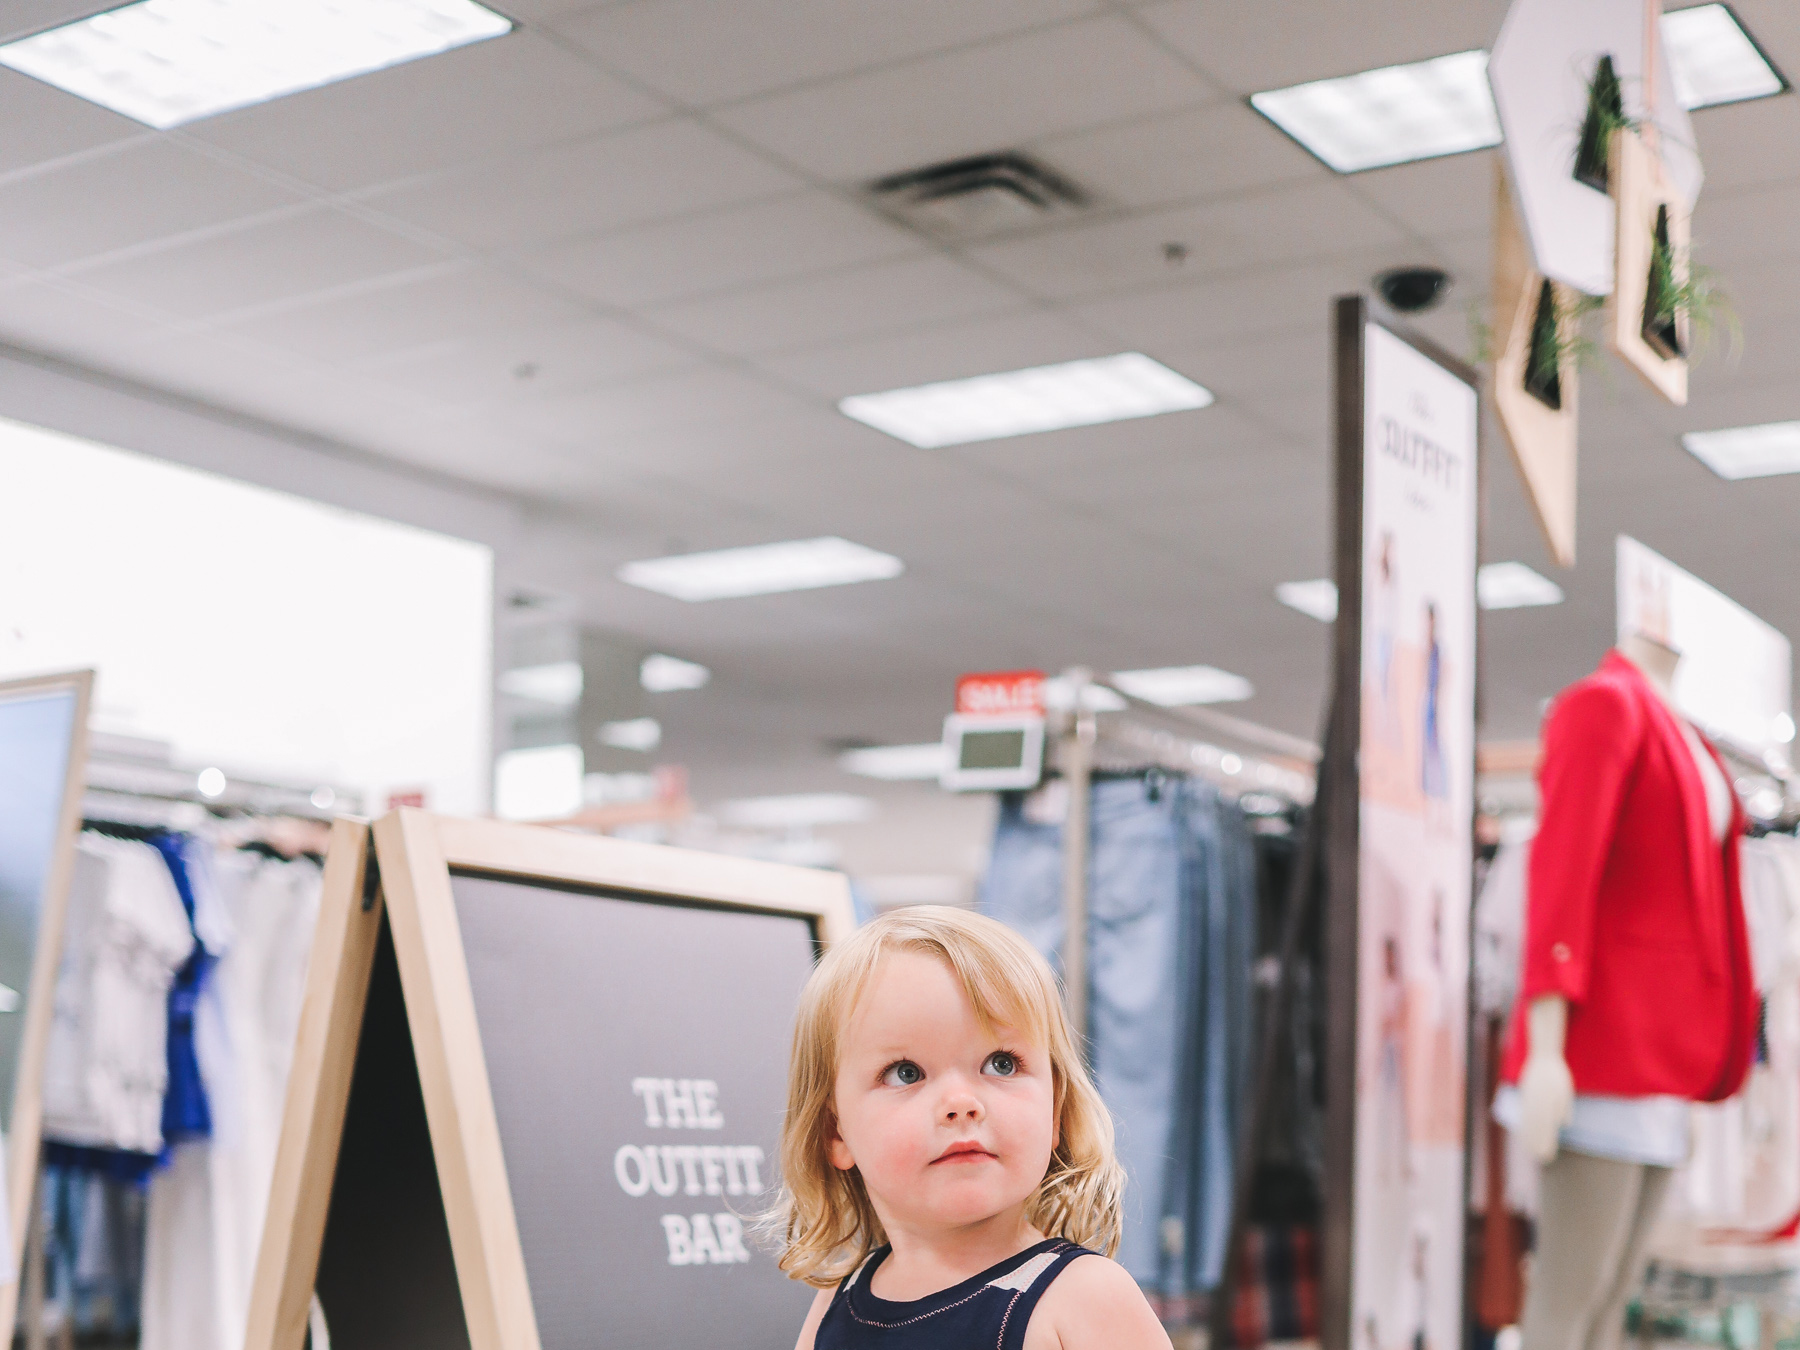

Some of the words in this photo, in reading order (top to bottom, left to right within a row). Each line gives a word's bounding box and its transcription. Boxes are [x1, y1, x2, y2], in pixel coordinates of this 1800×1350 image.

[632, 1076, 725, 1130] THE
[613, 1143, 766, 1197] OUTFIT
[659, 1212, 751, 1267] BAR
